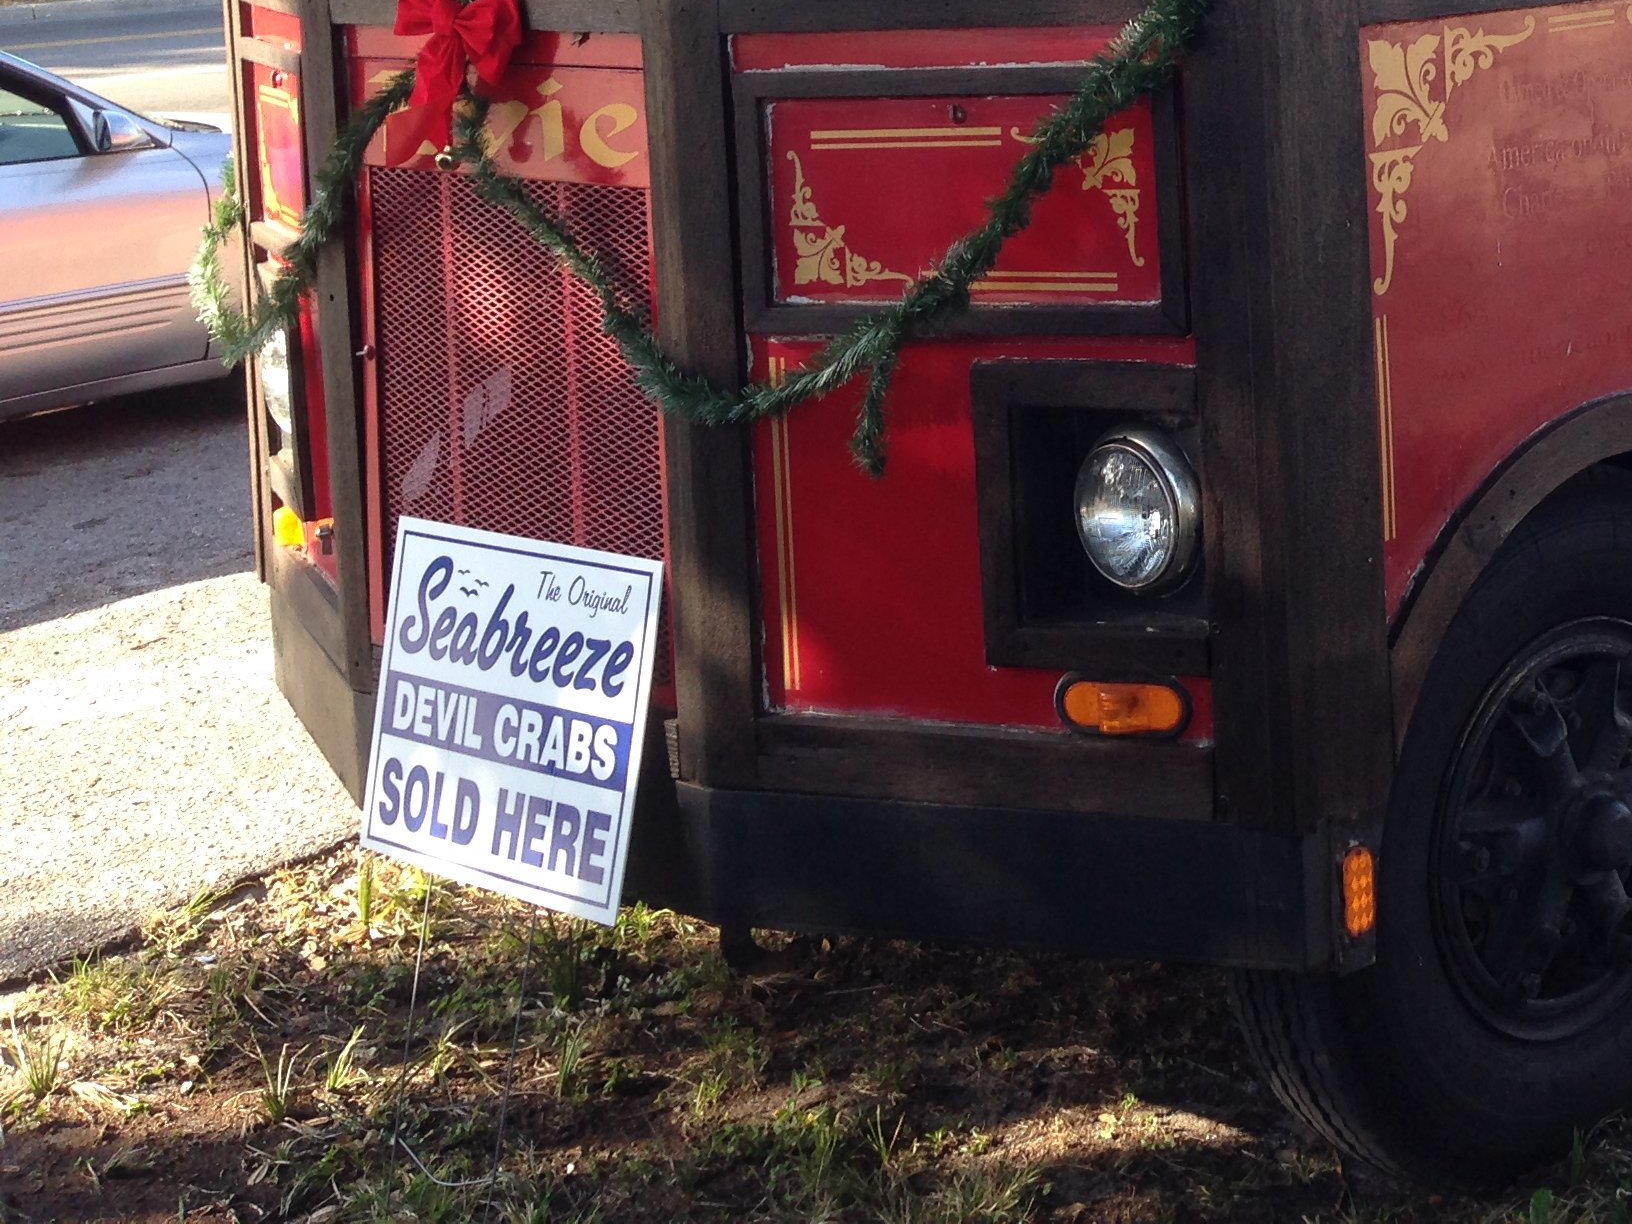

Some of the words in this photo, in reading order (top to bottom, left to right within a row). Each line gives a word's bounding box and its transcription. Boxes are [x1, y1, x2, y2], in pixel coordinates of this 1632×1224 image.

[399, 555, 634, 697] Seabreeze
[536, 570, 562, 602] The
[568, 575, 630, 618] Original
[392, 680, 482, 750] DEVIL
[493, 703, 619, 780] CRABS
[378, 757, 480, 846] SOLD
[491, 787, 612, 885] HERE
